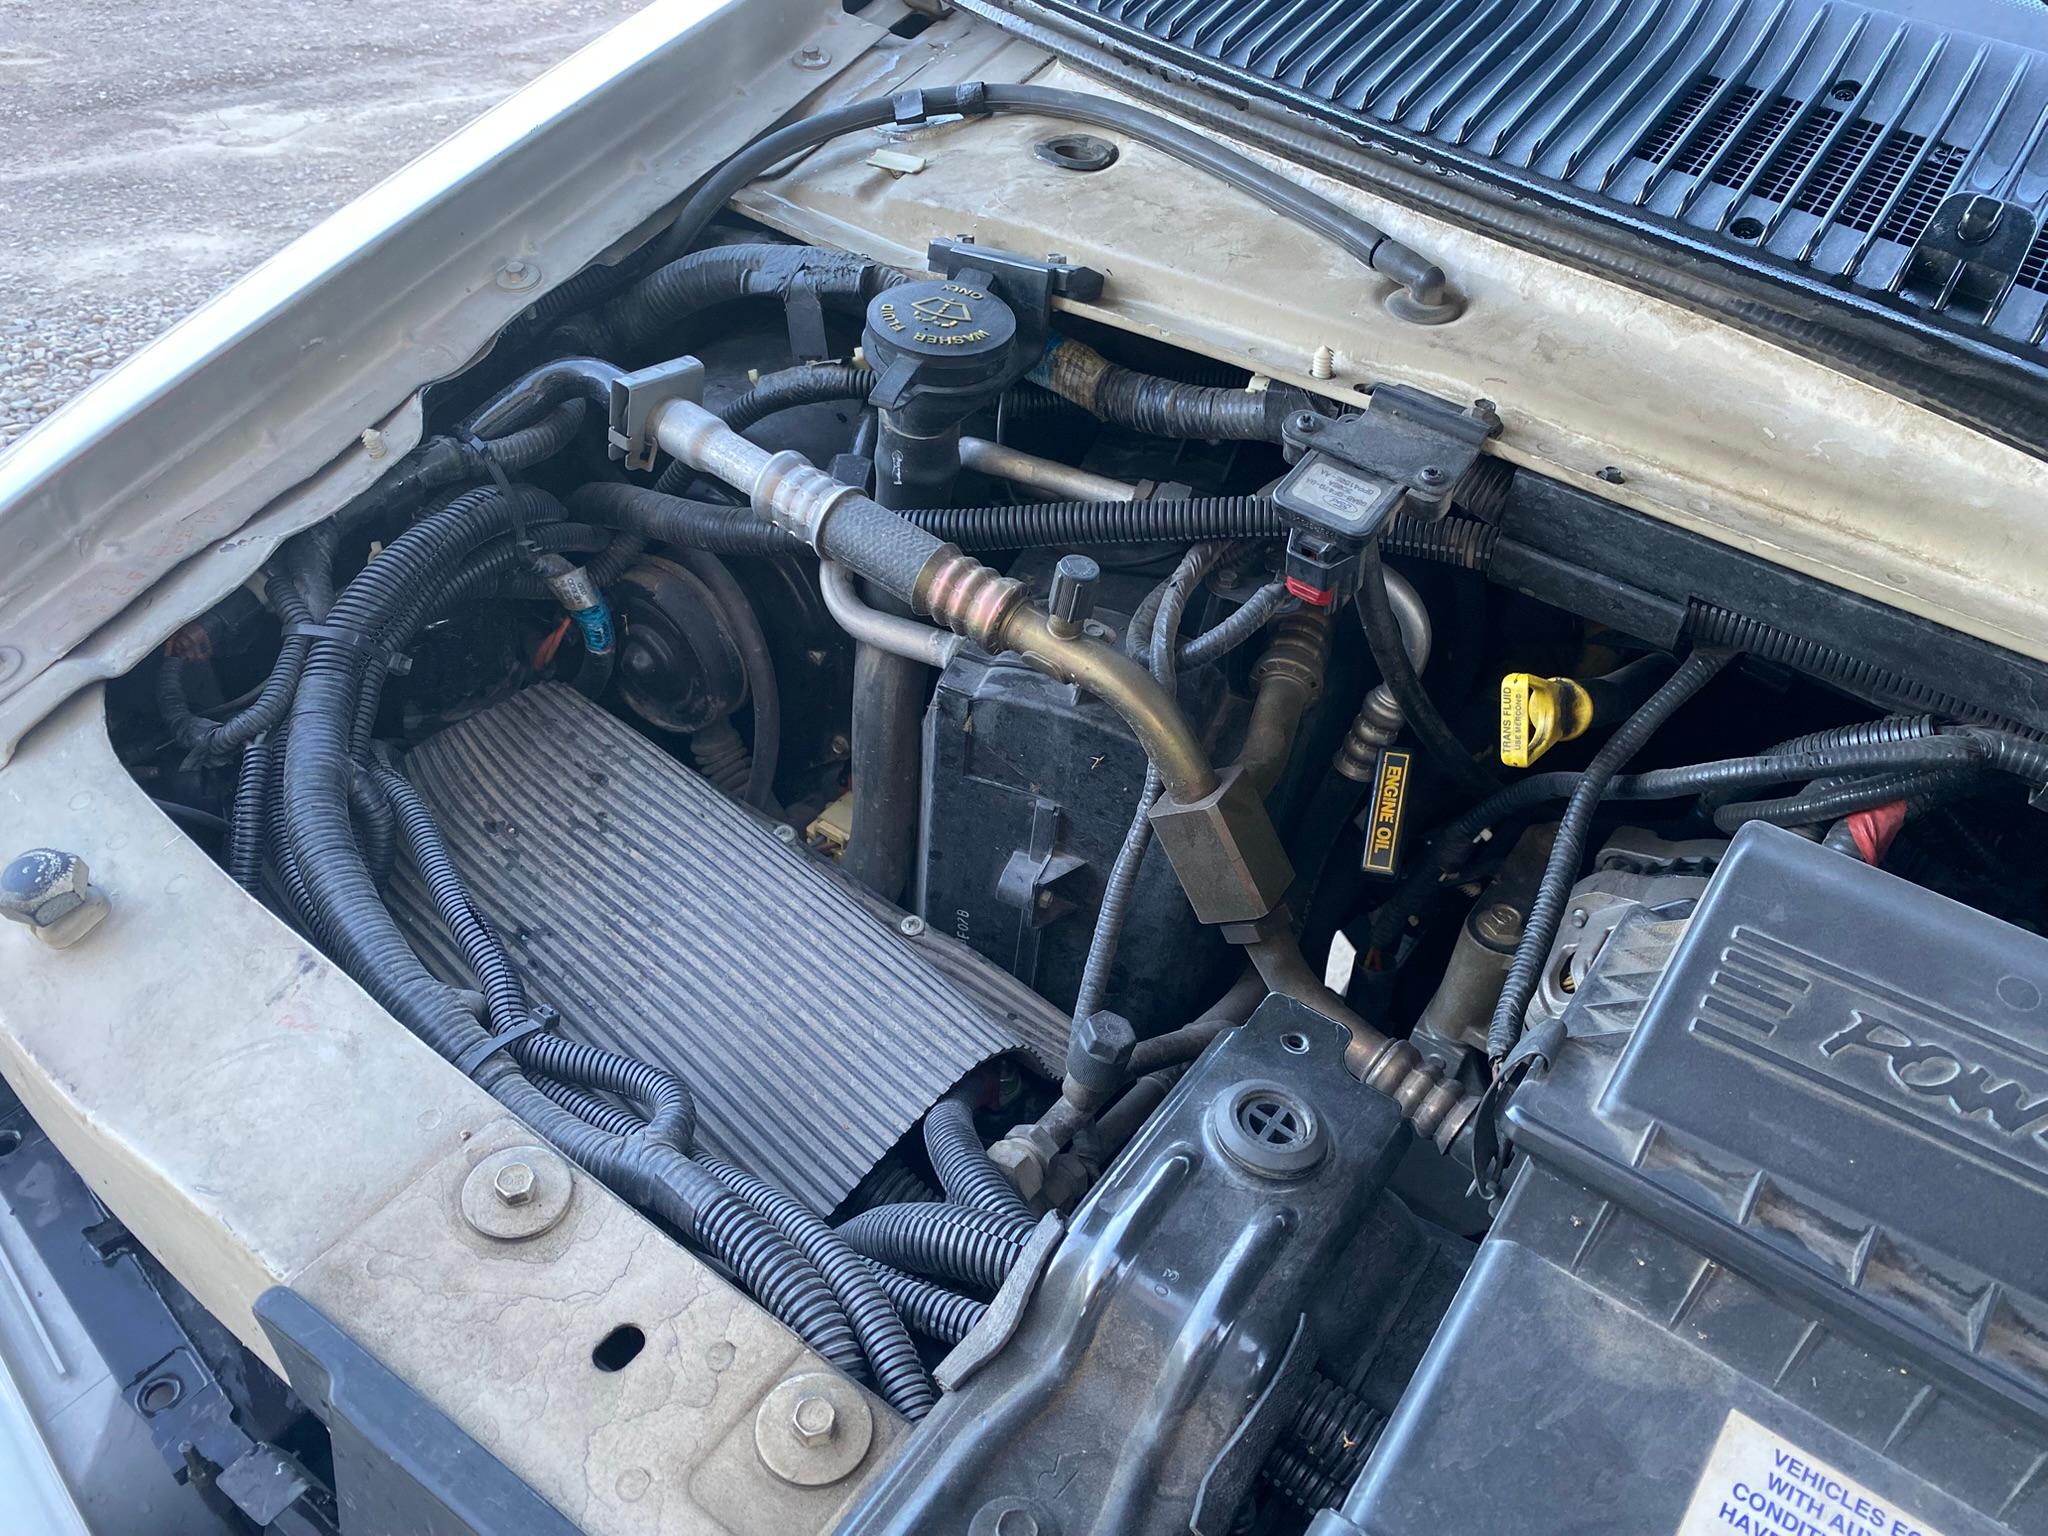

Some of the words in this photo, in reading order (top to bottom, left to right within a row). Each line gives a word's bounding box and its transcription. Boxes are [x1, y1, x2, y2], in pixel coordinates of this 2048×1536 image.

[940, 284, 984, 300] ONLY
[881, 303, 906, 332] FLUID
[913, 329, 991, 345] WASHER
[1502, 686, 1512, 717] FLUID
[1502, 719, 1512, 754] TRANS
[1514, 735, 1522, 751] USE
[1379, 766, 1402, 823] ENGINE
[1374, 826, 1392, 854] OIL
[1775, 1448, 1886, 1528] VEHICLES
[1768, 1472, 1825, 1520] WITH
[1828, 1513, 1874, 1536] AU
